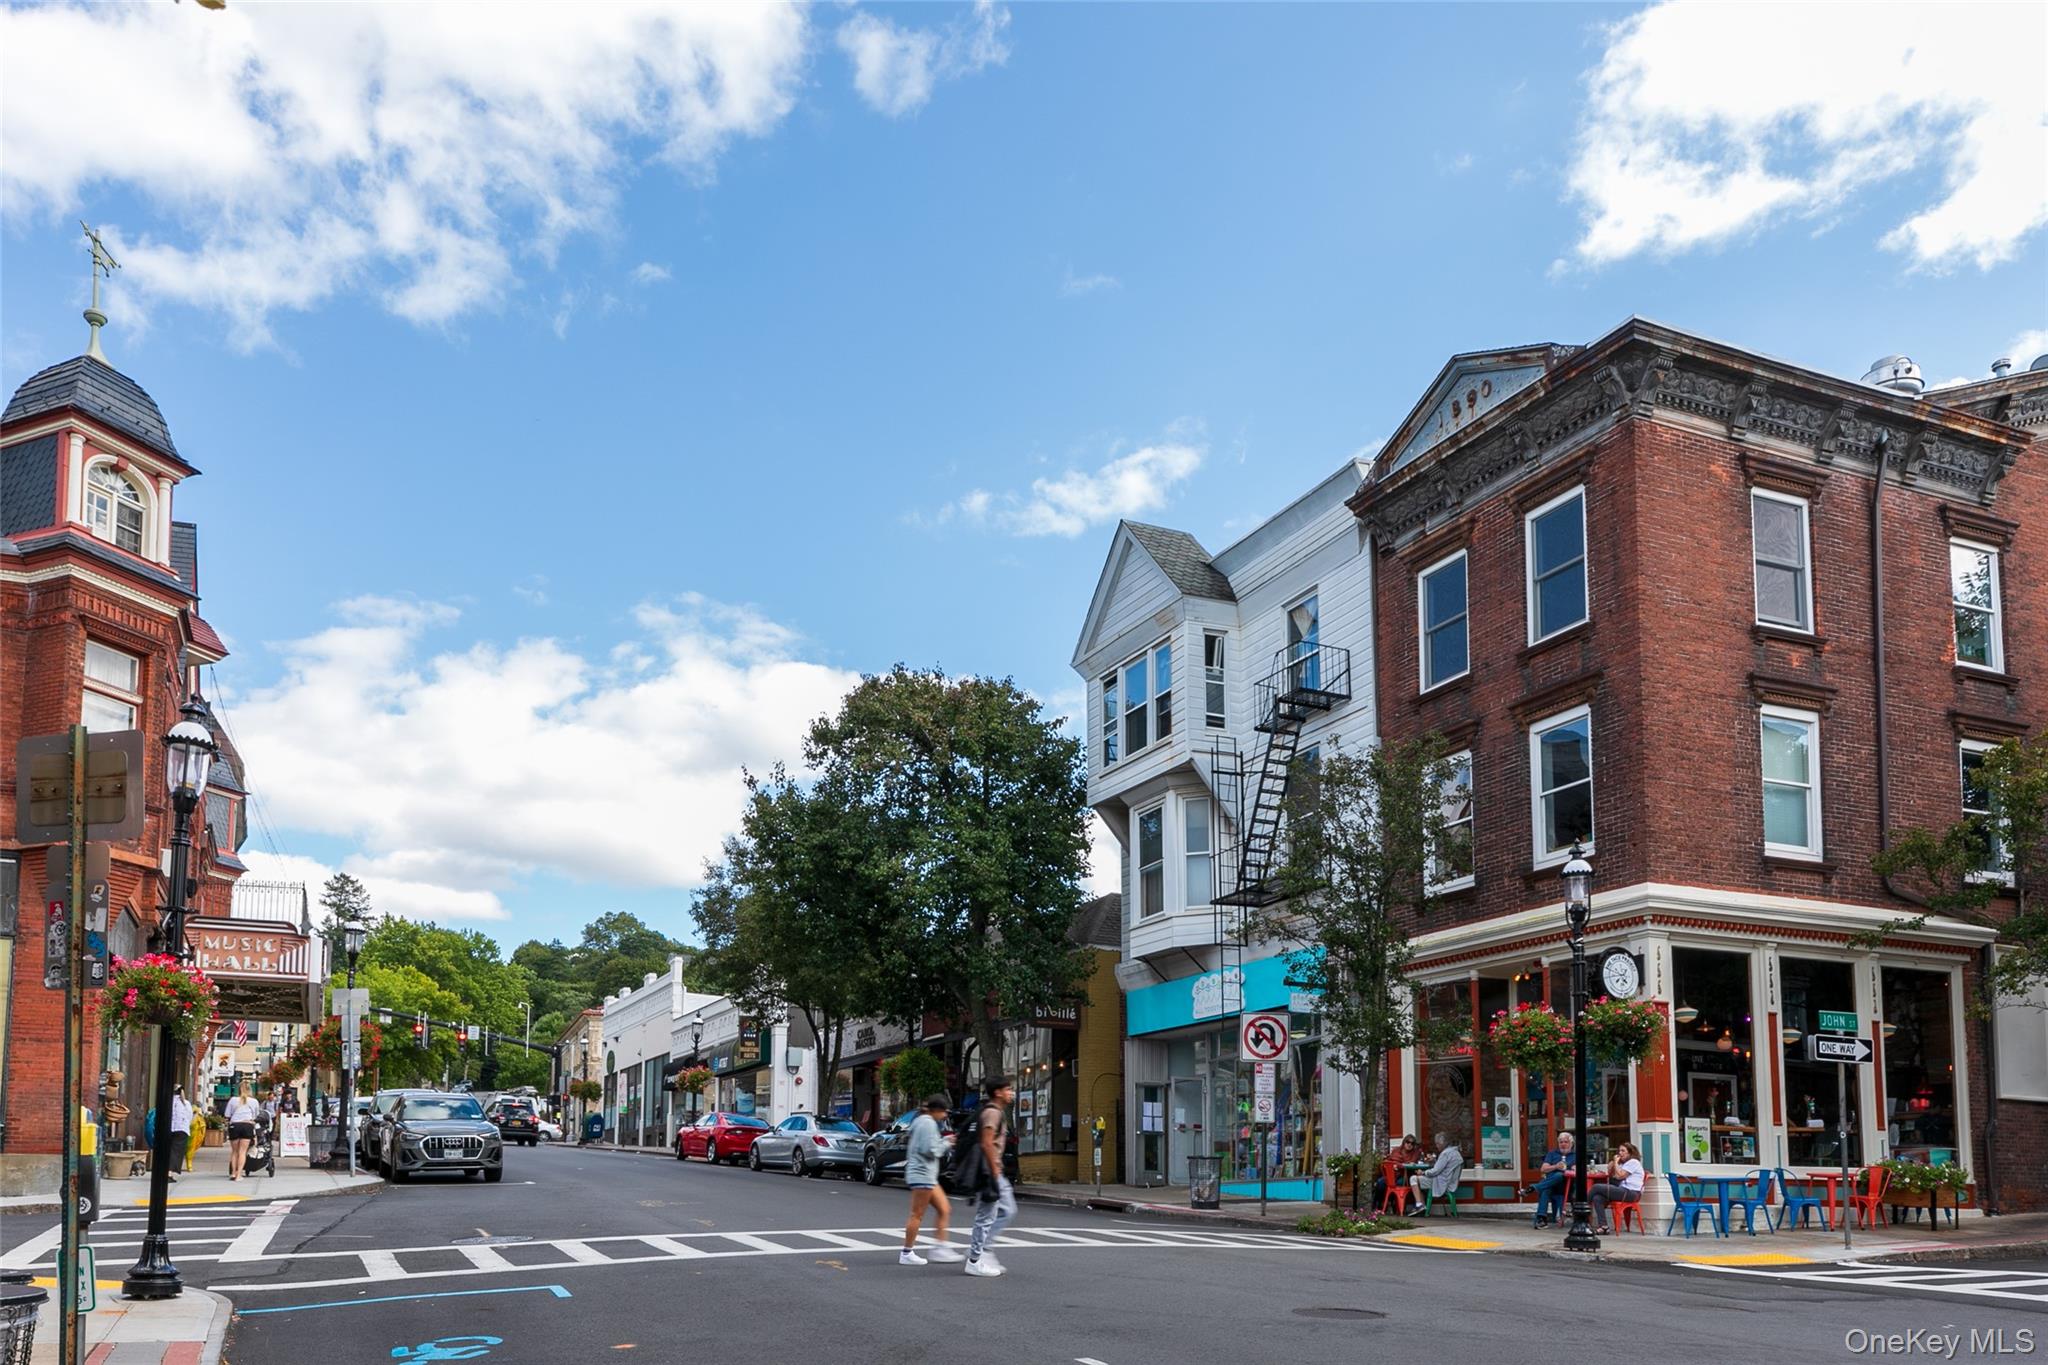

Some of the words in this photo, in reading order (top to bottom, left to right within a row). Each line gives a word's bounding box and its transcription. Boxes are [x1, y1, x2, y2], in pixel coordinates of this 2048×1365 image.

[1438, 379, 1492, 428] 1890
[204, 935, 277, 953] MUSIC
[202, 953, 278, 972] HALL
[1035, 1004, 1077, 1020] bibillé
[1822, 1014, 1846, 1027] JOHN
[1821, 1042, 1837, 1053] ONE
[1840, 1044, 1856, 1054] WAY
